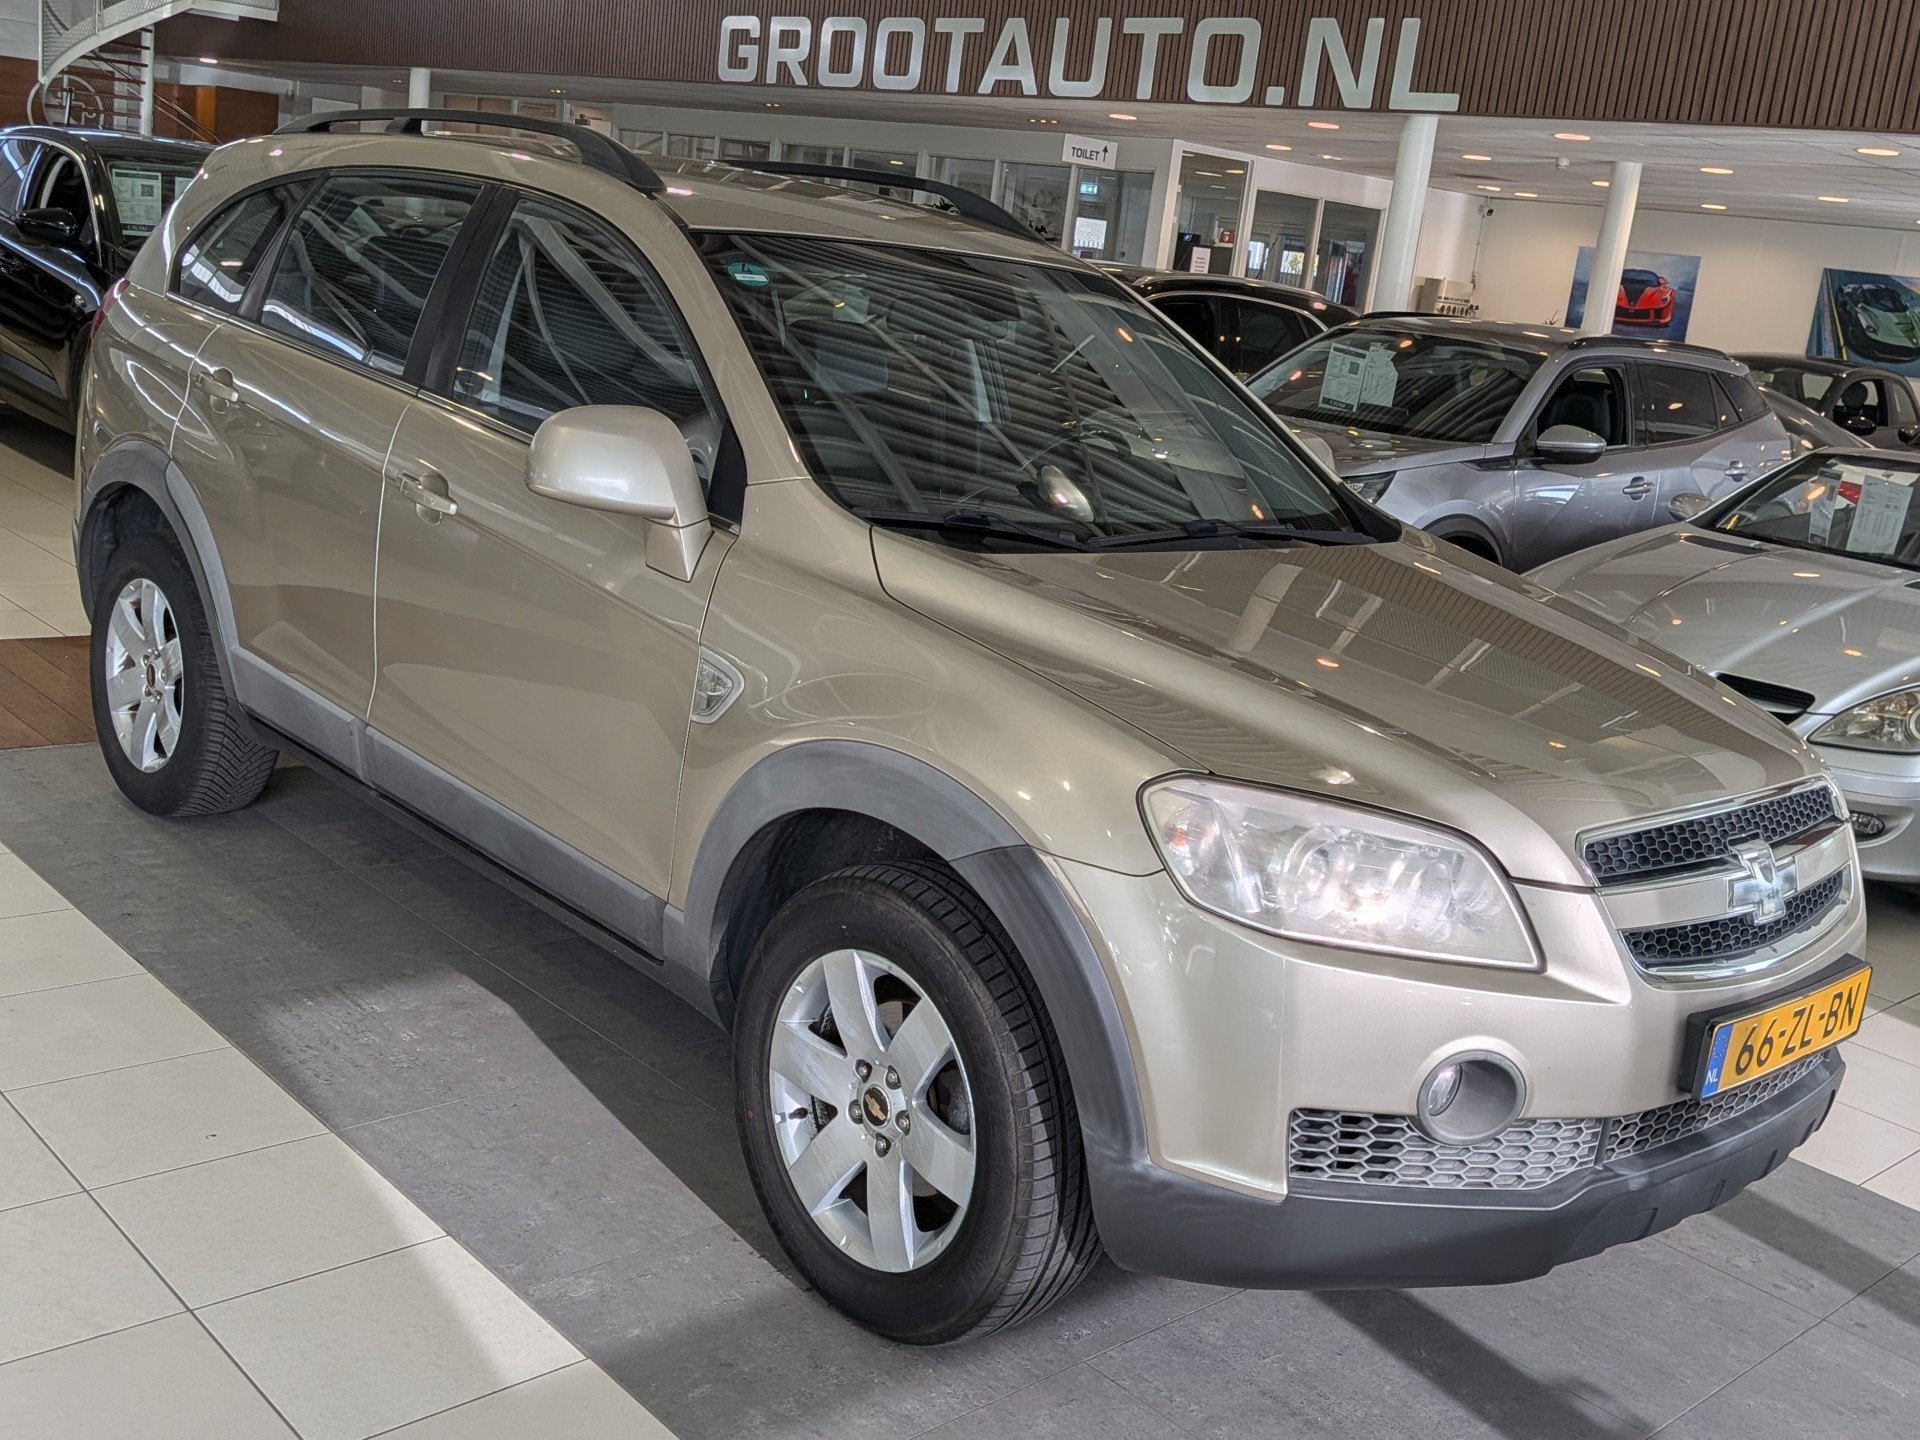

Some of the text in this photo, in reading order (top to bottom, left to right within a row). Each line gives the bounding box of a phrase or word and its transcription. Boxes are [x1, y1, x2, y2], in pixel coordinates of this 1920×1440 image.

[717, 15, 1461, 112] GROOTAUTO.NL
[1071, 146, 1100, 161] TOILET
[1736, 981, 1861, 1076] 66-ZL-BN
[1706, 1068, 1718, 1083] NL
